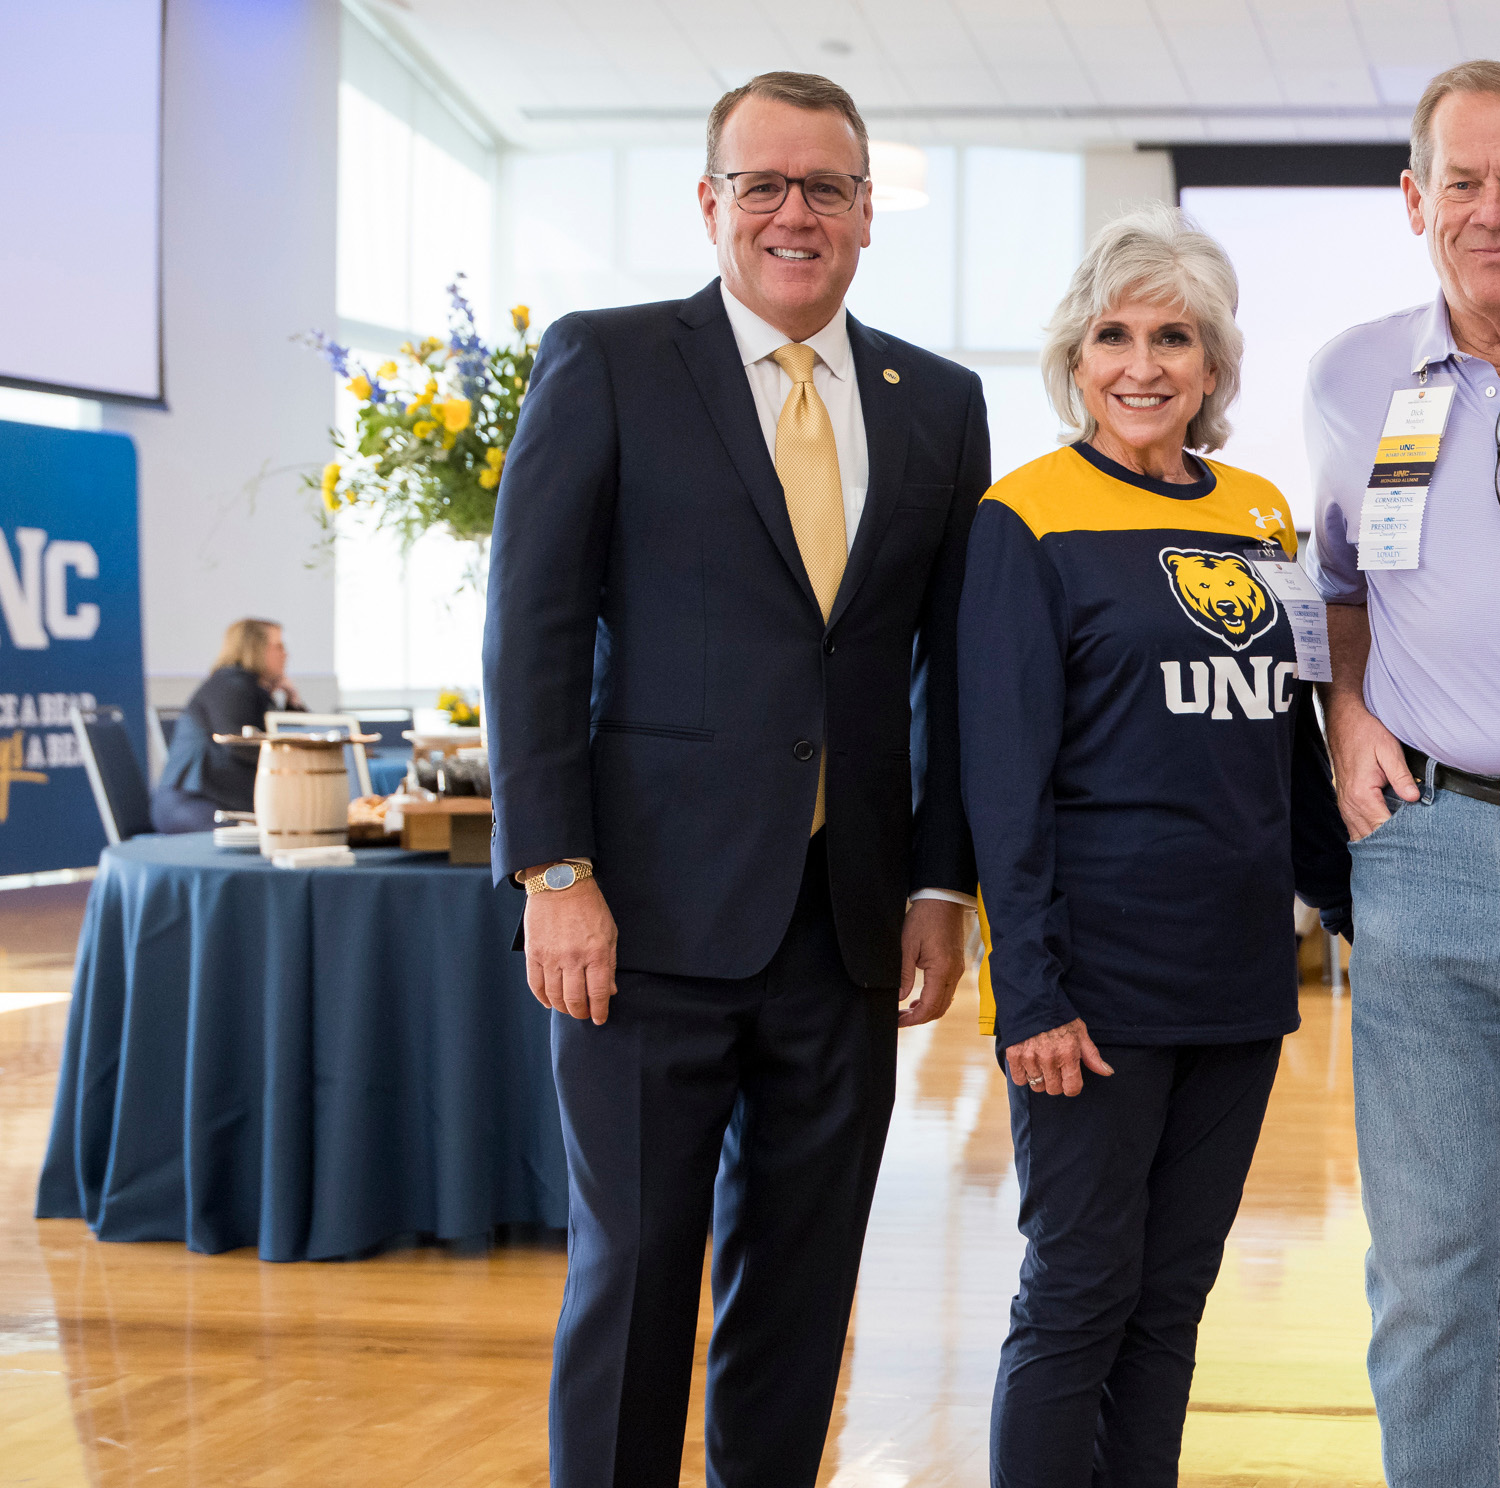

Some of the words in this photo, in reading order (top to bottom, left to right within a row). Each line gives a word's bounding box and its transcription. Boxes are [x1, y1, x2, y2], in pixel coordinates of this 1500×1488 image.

[1410, 408, 1424, 416] Dick
[1393, 470, 1410, 478] UNC
[1160, 656, 1299, 720] UNC
